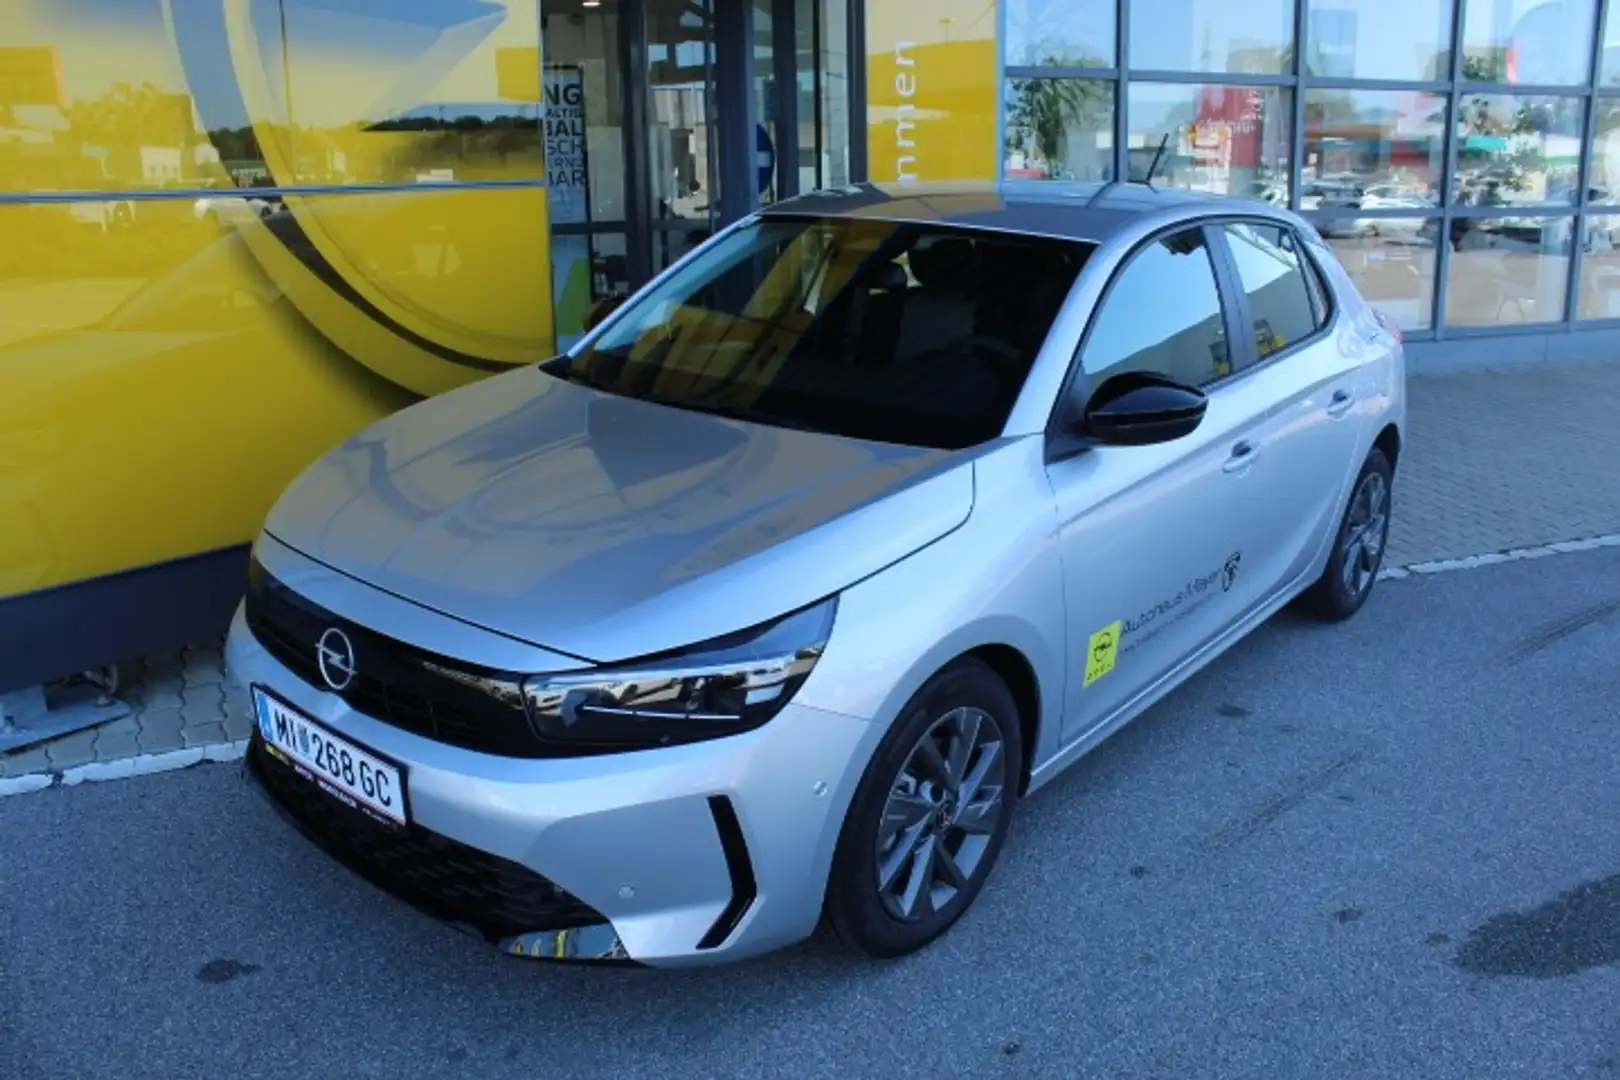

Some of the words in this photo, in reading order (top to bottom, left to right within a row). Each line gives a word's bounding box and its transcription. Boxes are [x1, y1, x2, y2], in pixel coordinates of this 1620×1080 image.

[274, 709, 298, 752] MI
[311, 732, 356, 787] 268
[359, 759, 392, 807] GC
